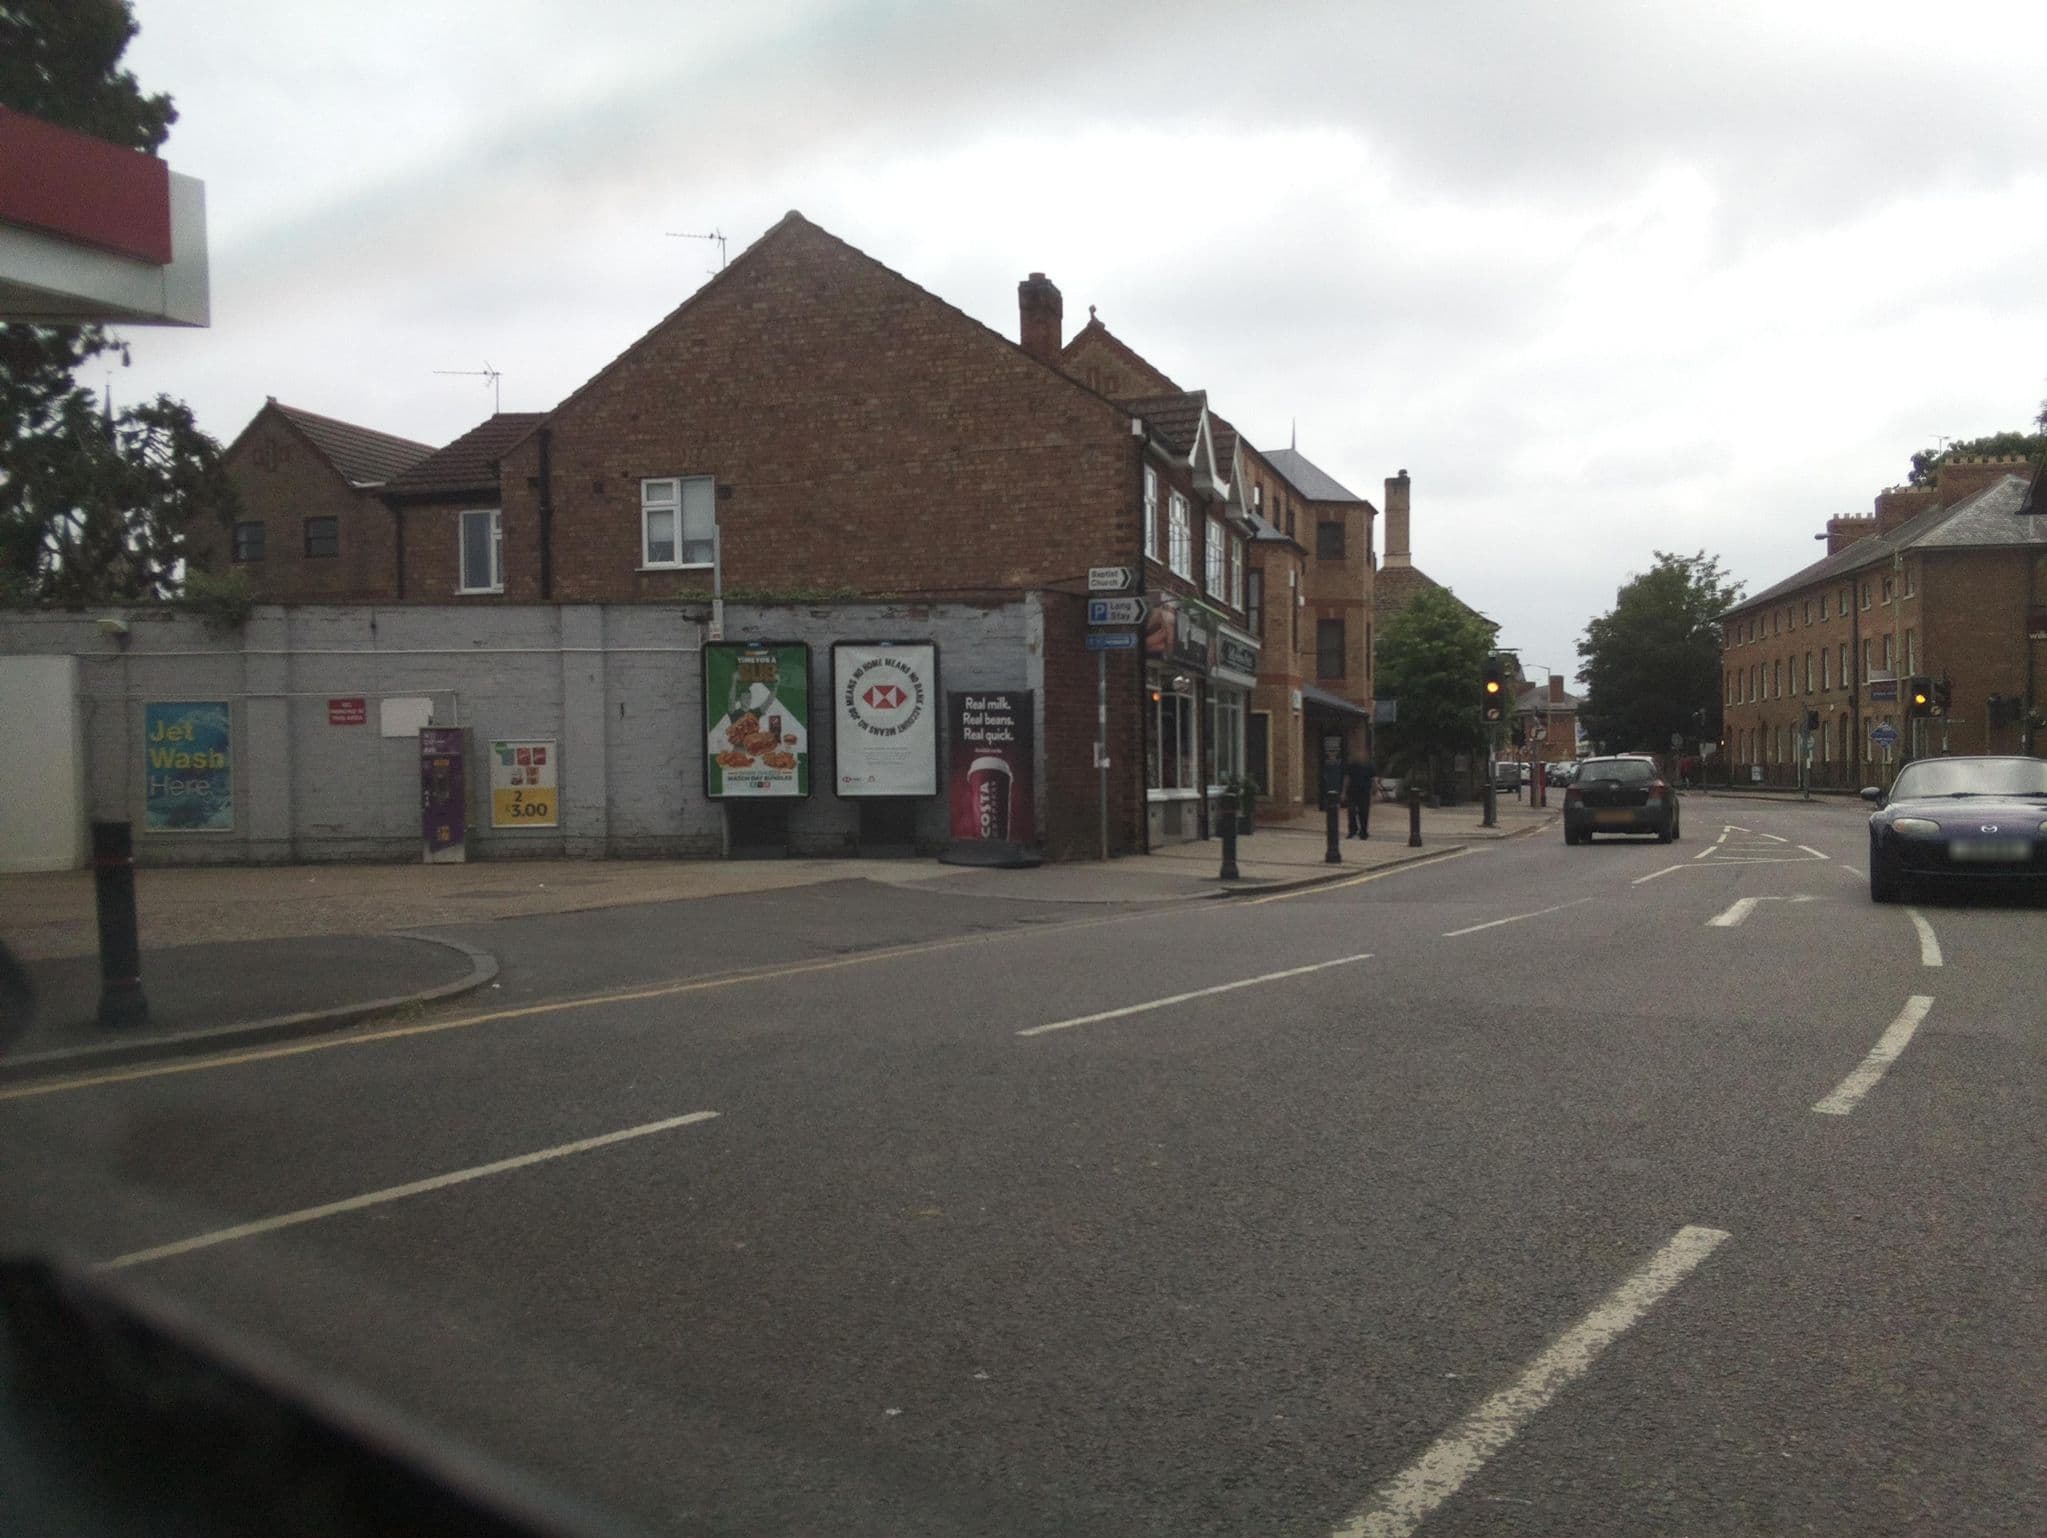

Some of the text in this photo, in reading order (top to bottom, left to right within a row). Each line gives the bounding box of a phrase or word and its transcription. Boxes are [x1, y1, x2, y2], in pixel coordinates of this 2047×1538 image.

[1110, 602, 1131, 611] Long
[1110, 612, 1130, 621] Stay
[845, 657, 924, 737] NO HOME MEANS NO BANK ACCOUNT MEANS NO JOB MEANS
[965, 696, 1011, 710] Real milk.
[962, 711, 1015, 726] Real beans.
[150, 719, 195, 742] Jet
[963, 727, 1015, 745] Real quick.
[149, 747, 225, 769] Wash
[150, 775, 210, 796] Here
[514, 790, 523, 802] 2
[980, 781, 992, 838] COSTA
